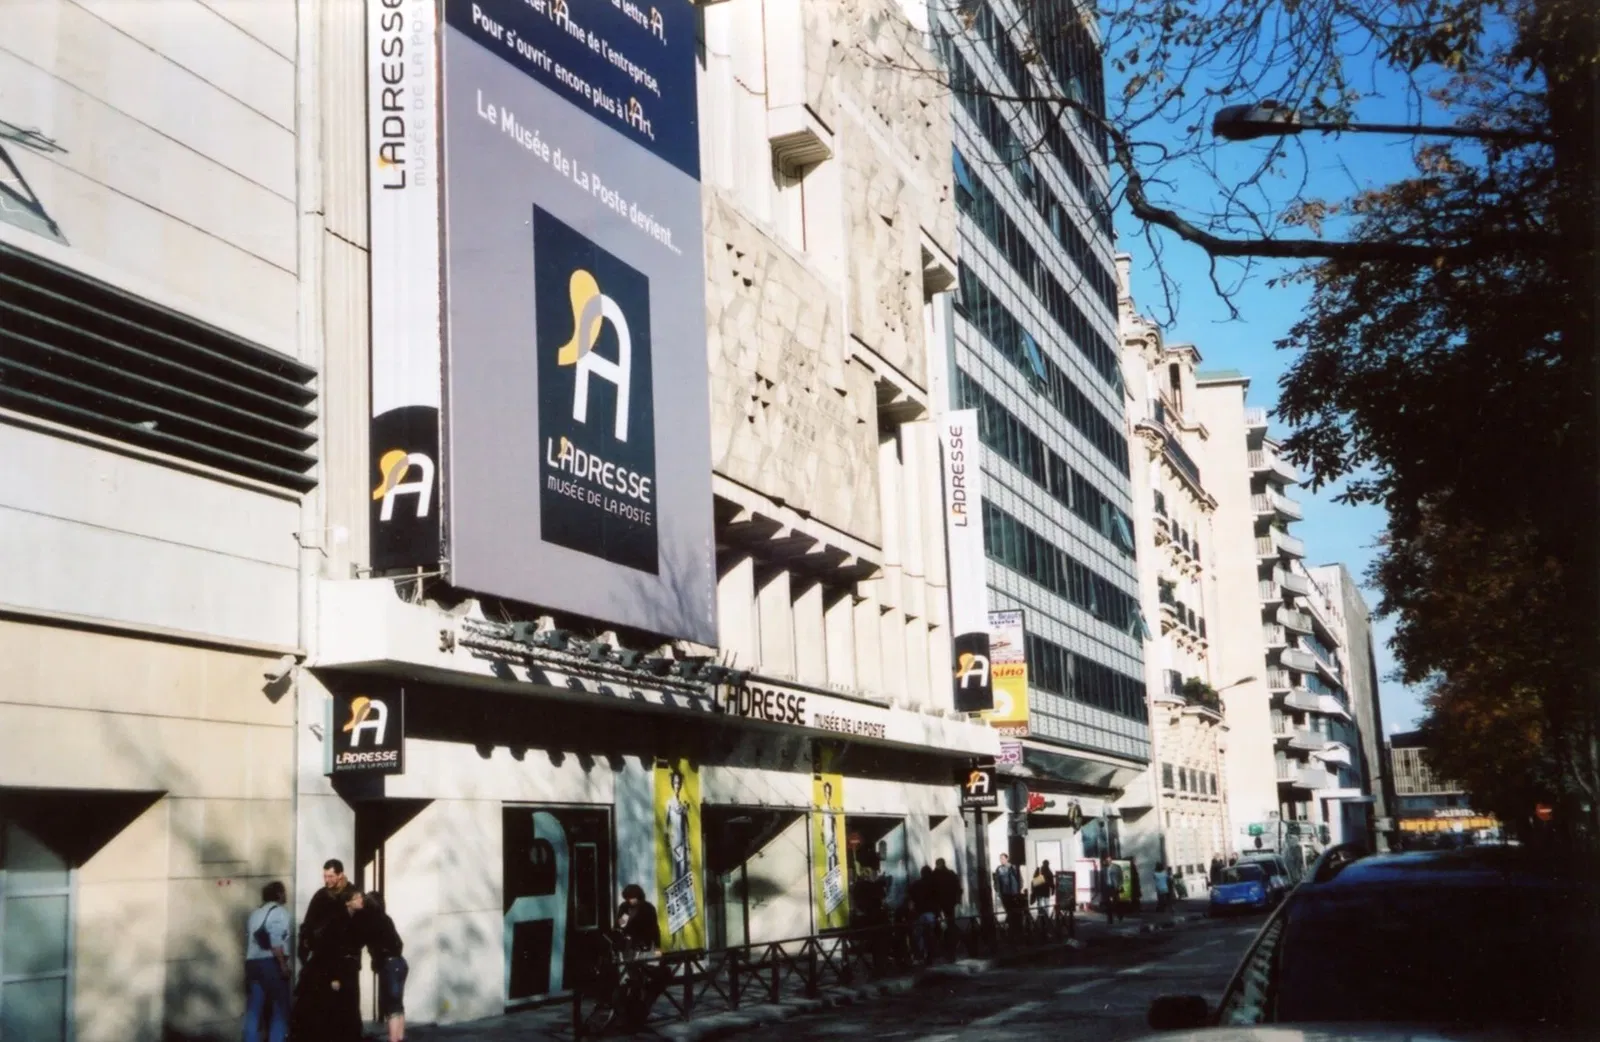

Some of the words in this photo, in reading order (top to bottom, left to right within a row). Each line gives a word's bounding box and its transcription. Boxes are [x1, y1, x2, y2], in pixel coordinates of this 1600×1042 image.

[472, 3, 504, 40] Pour
[506, 29, 552, 72] s'ouvrir
[555, 62, 592, 98] encore
[593, 88, 615, 112] plus
[616, 97, 623, 119] à
[587, 31, 600, 53] de
[476, 88, 497, 125] Le
[501, 106, 550, 164] Musée
[552, 147, 570, 178] de
[573, 159, 590, 192] La
[591, 173, 628, 217] Poste
[547, 475, 585, 502] MUSÉE
[587, 490, 602, 508] DE
[604, 497, 618, 514] LA
[619, 502, 652, 526] POSTE
[814, 711, 840, 731] MUSÉE
[841, 719, 851, 732] DE
[853, 720, 863, 735] LA
[864, 722, 886, 739] POSTE
